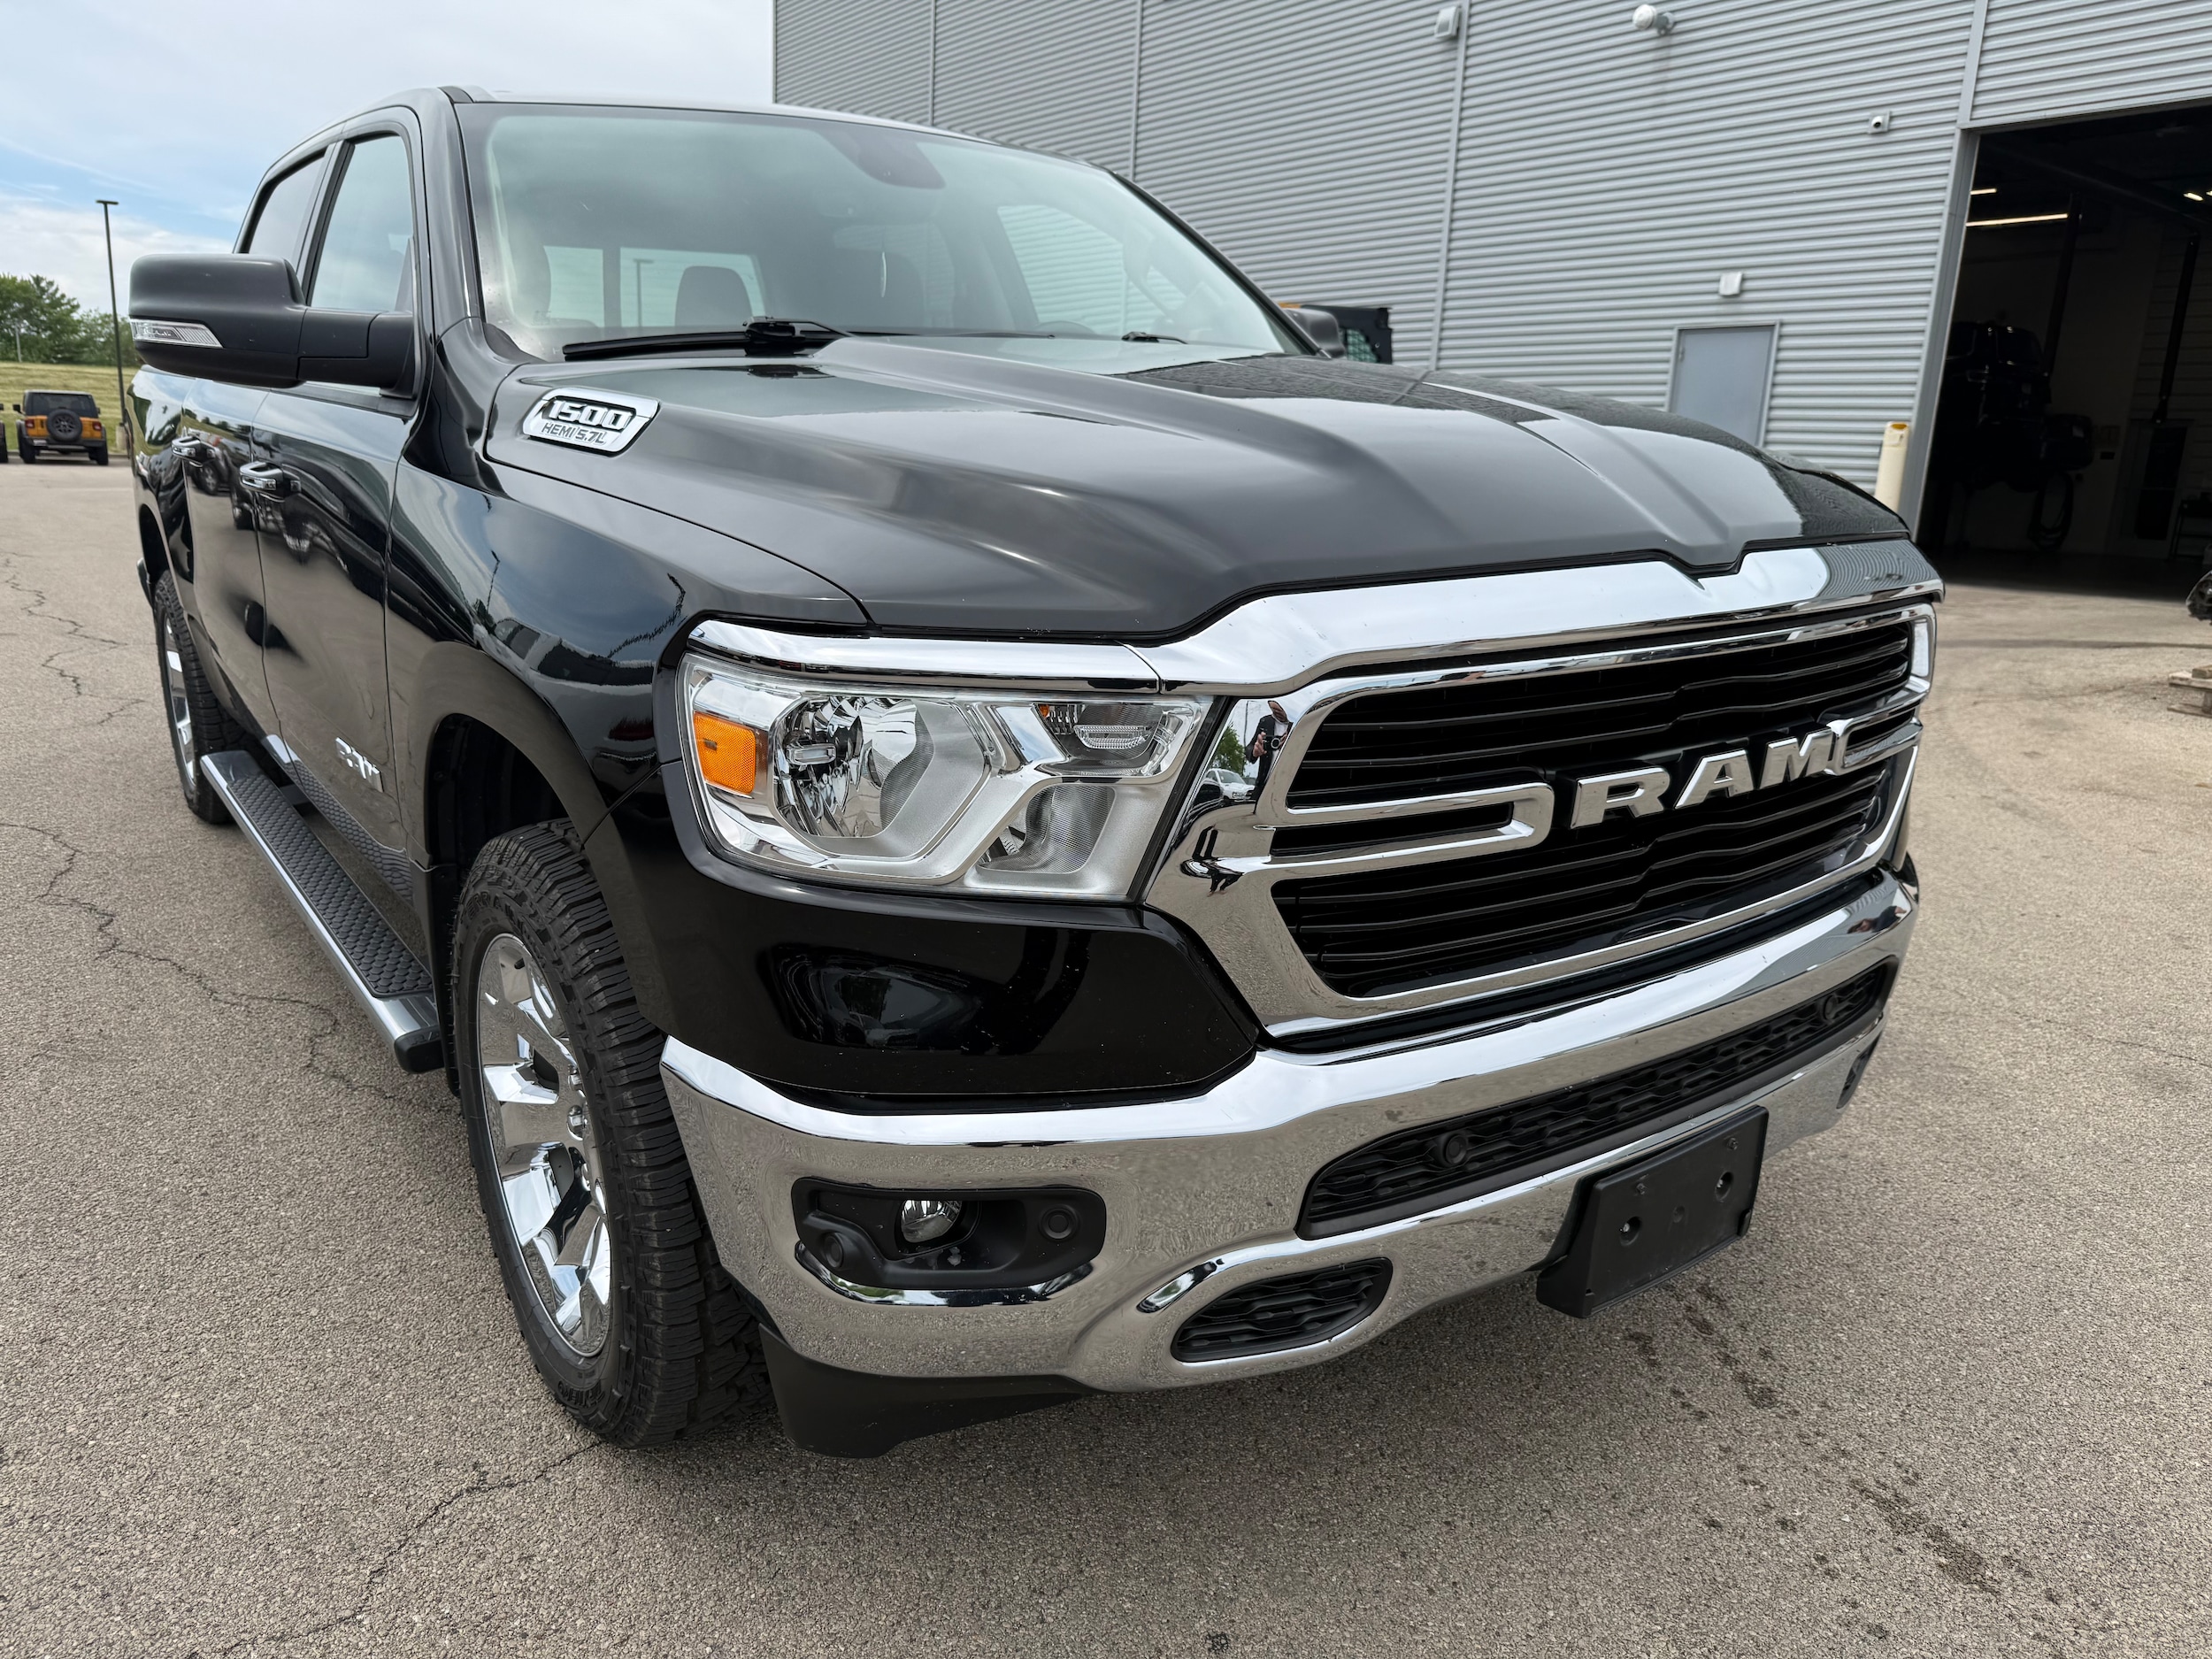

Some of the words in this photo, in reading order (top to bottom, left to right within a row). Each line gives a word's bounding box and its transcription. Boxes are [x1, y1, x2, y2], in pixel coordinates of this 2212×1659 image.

[549, 400, 633, 430] 1500
[541, 423, 576, 438] HEMI
[575, 428, 605, 443] 5.7L
[1571, 728, 1834, 829] RAM
